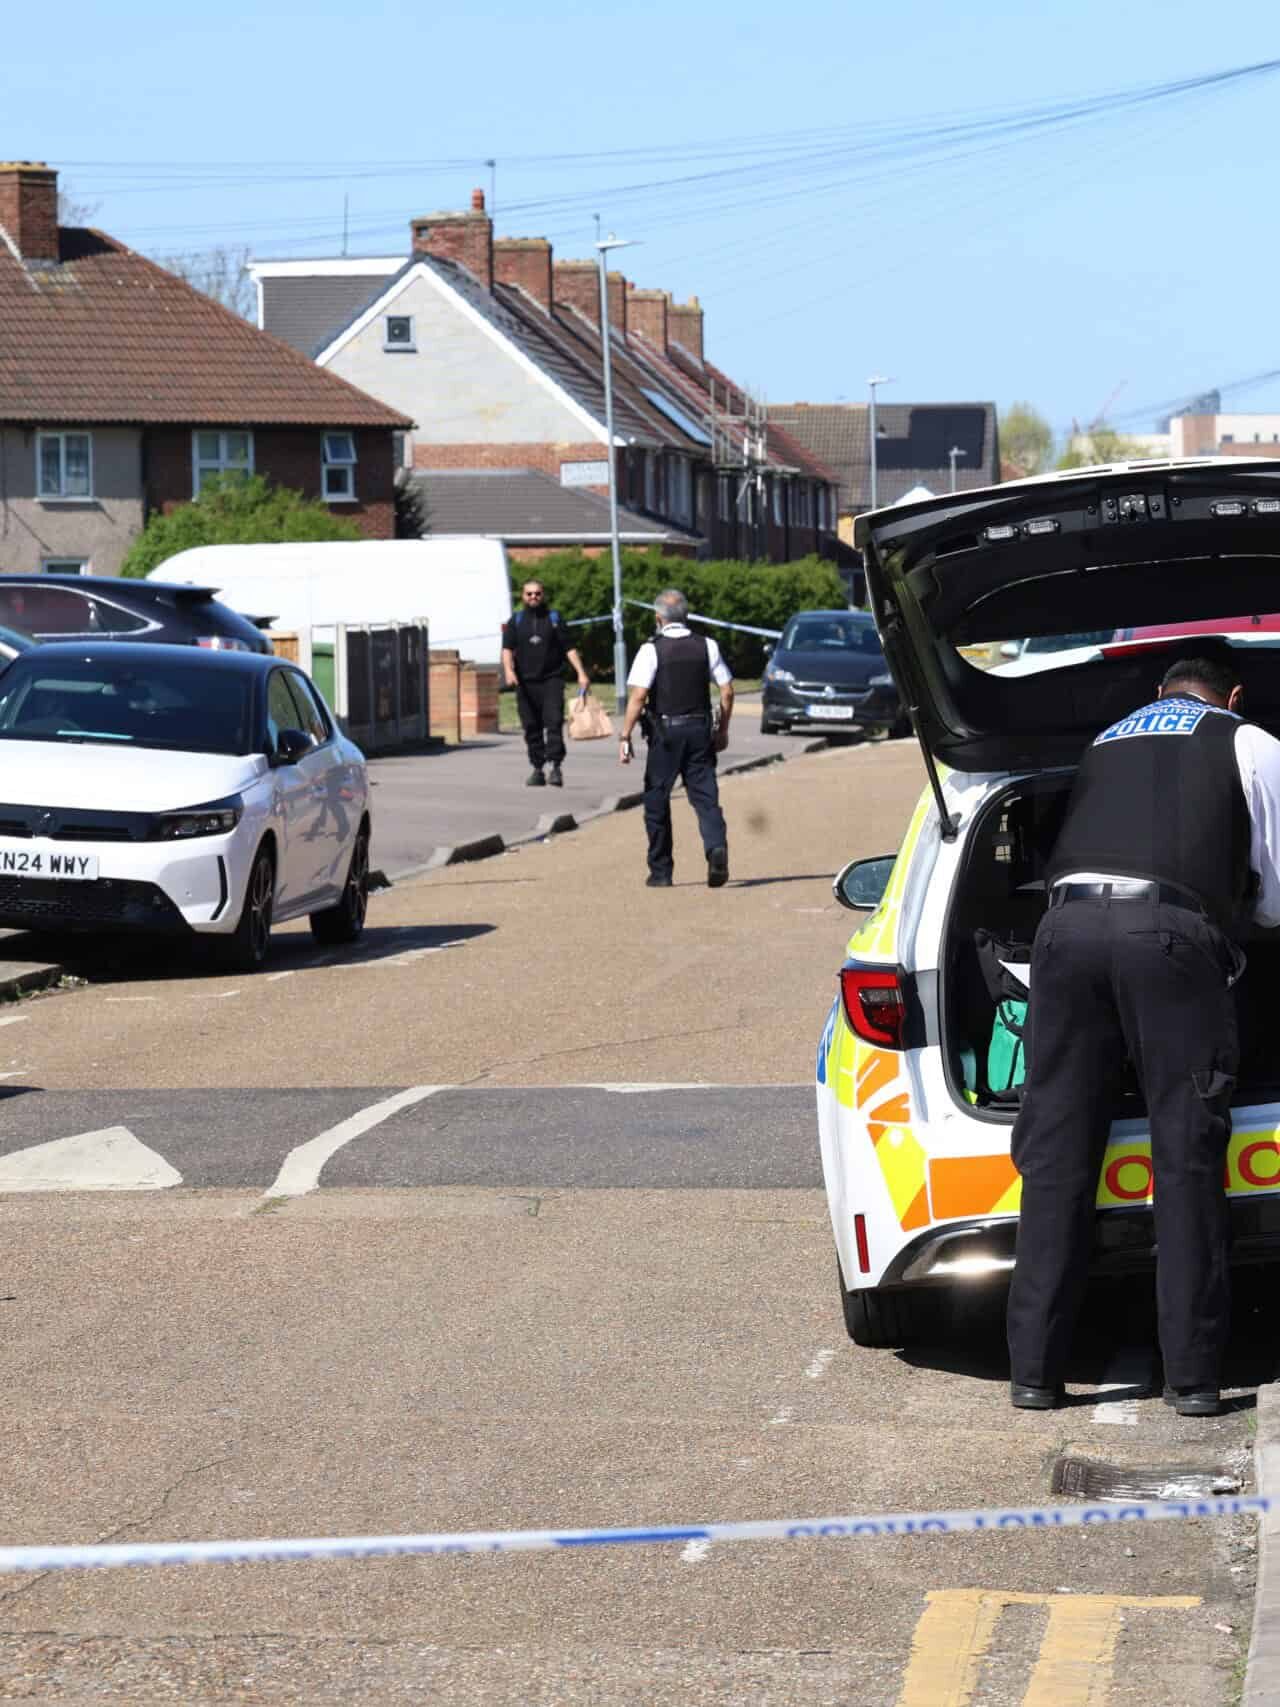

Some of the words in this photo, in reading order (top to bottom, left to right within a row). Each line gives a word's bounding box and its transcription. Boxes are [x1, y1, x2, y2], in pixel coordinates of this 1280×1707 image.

[1098, 714, 1196, 739] POLICE
[0, 852, 42, 872] N24
[50, 855, 89, 875] WWY
